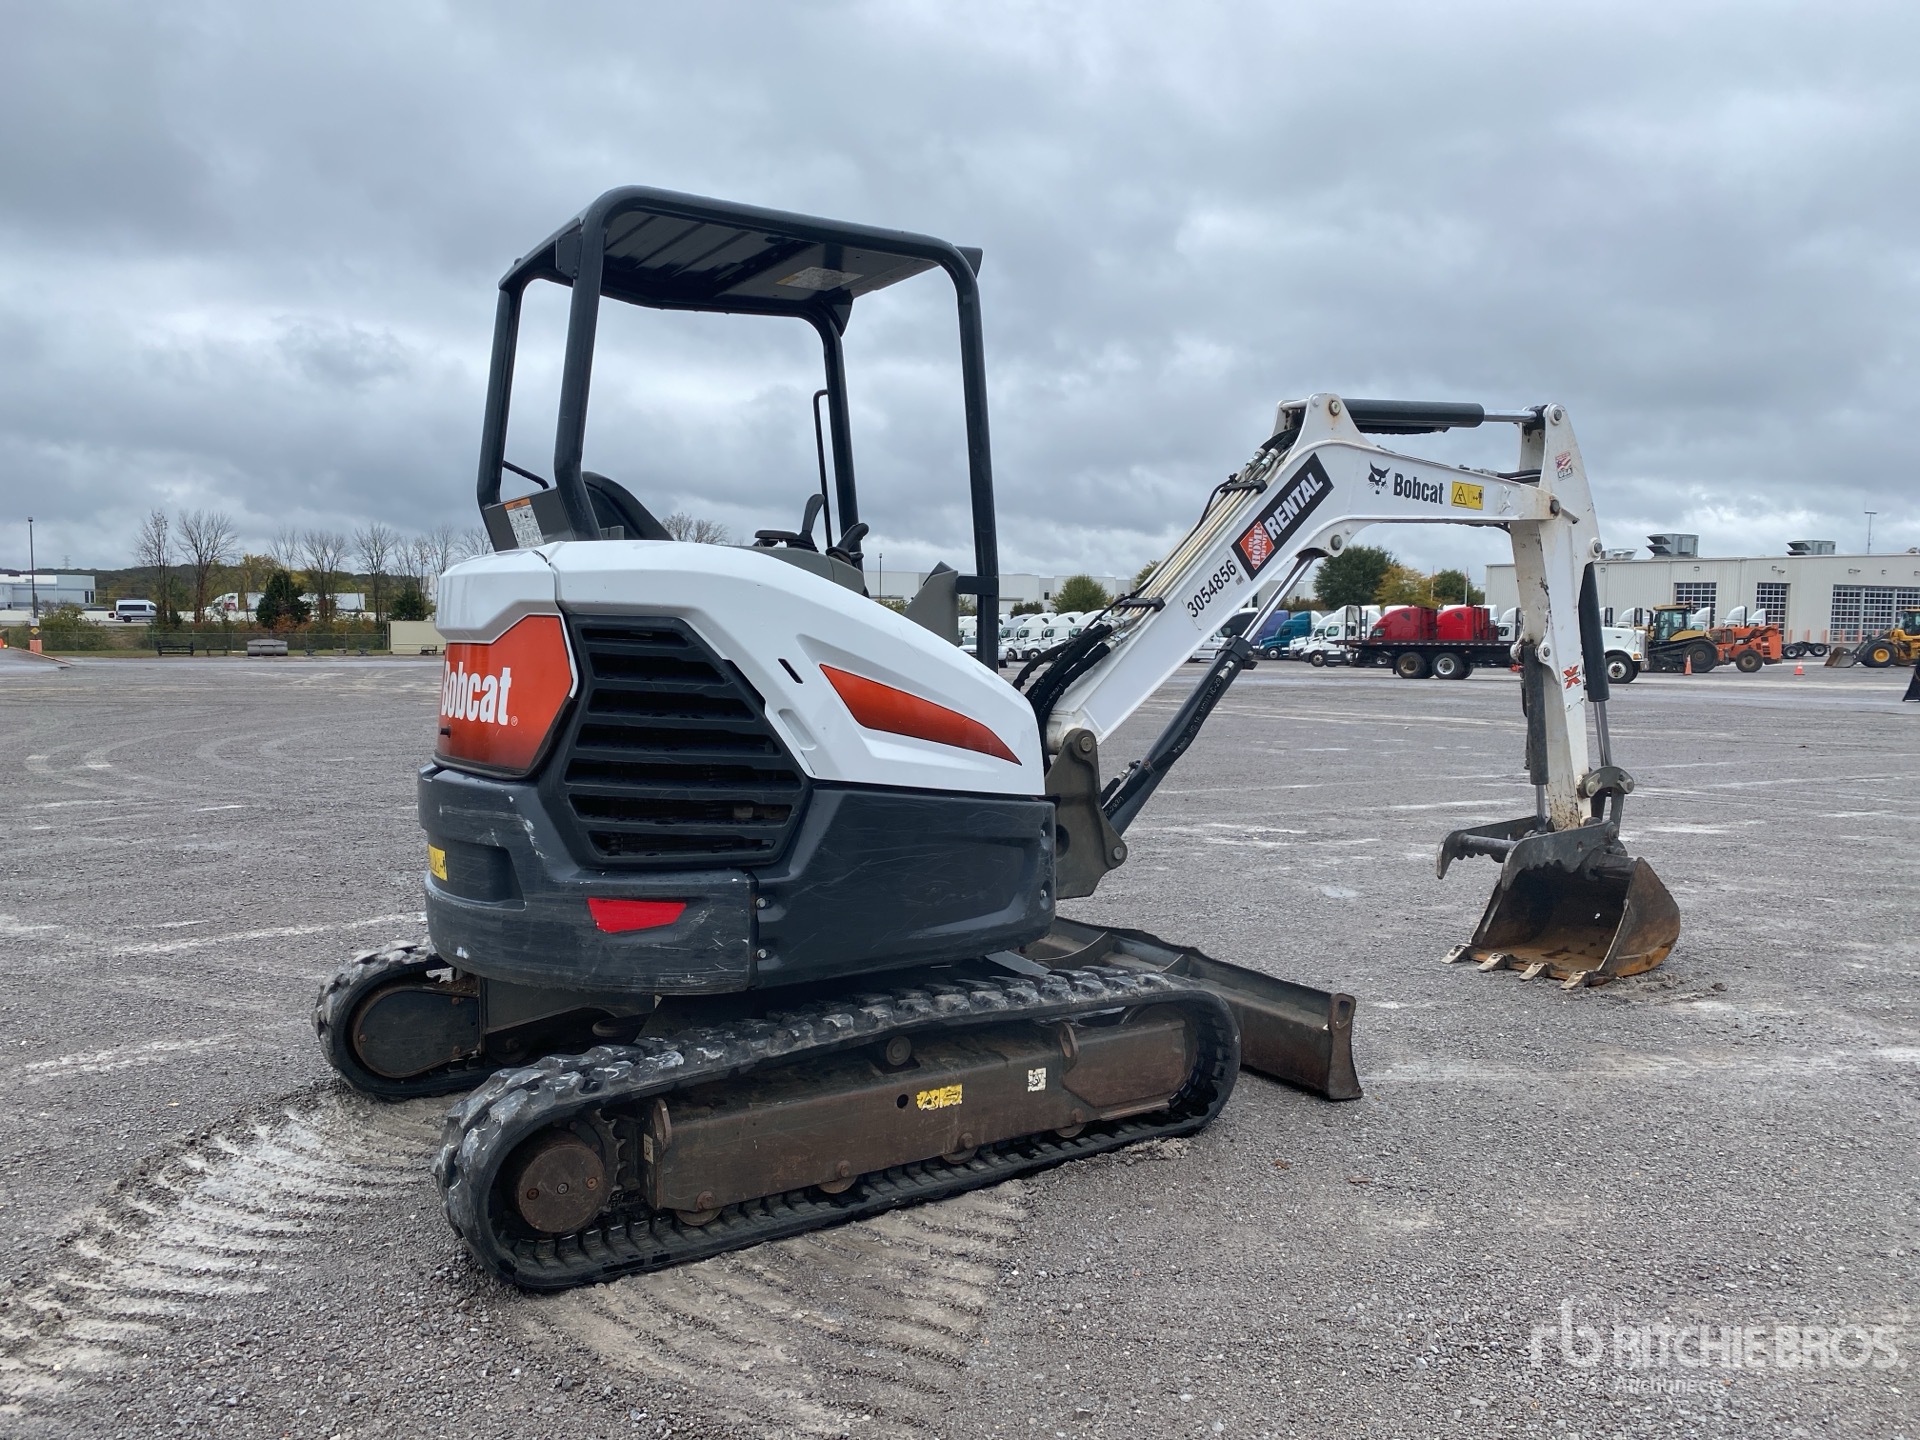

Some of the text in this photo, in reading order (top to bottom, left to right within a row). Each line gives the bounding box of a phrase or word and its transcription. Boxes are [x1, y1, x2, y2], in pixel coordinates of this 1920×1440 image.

[1264, 472, 1324, 541] RENTAL
[1393, 472, 1444, 505] Bobcat
[1252, 525, 1263, 565] HOME
[1187, 559, 1237, 618] 3054856
[441, 661, 512, 726] Bobcat
